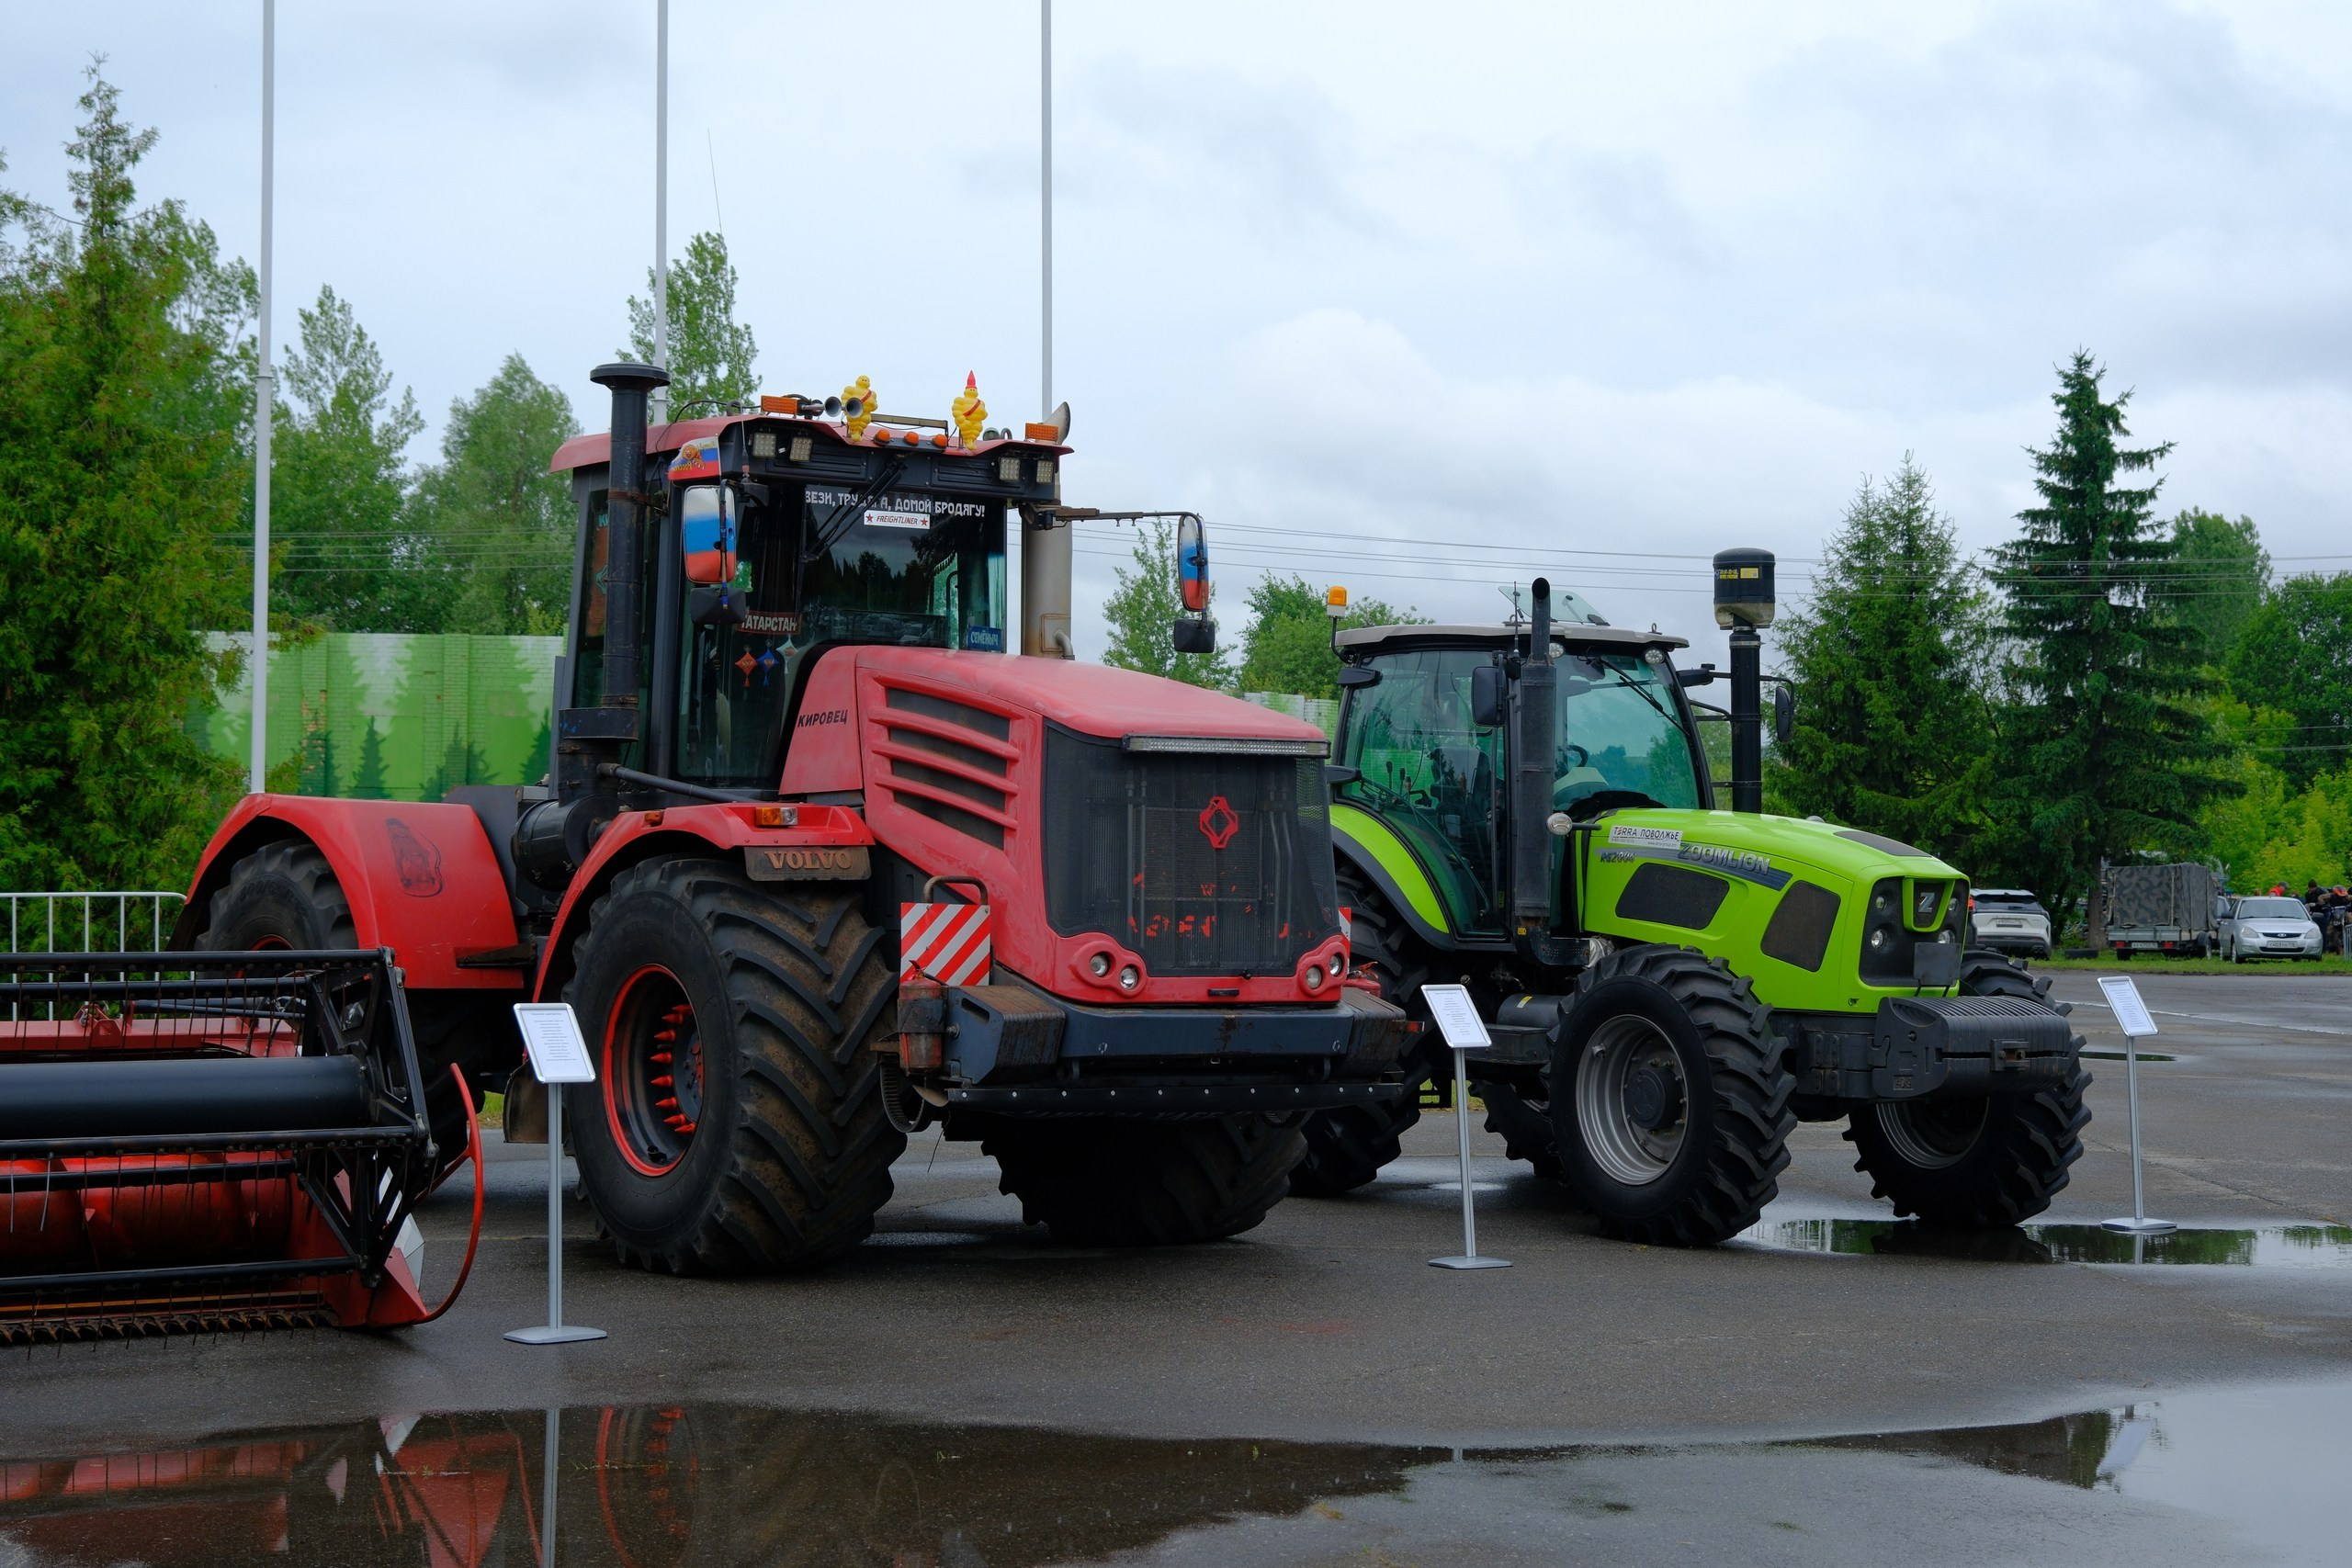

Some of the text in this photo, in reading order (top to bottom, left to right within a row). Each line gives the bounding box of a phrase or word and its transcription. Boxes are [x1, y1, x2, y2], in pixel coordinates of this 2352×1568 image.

[805, 491, 986, 517] ВЕЗИ, ТРУДЯА, ДОМОЙ БРОДЯГУ!
[876, 515, 919, 525] FREIGHTLINER
[797, 709, 849, 728] КИРОВЕЦ
[1640, 829, 1679, 840] ПОВОЛЖЬЕ
[763, 850, 853, 870] VOLVO
[1678, 842, 1771, 875] ZOOMLION
